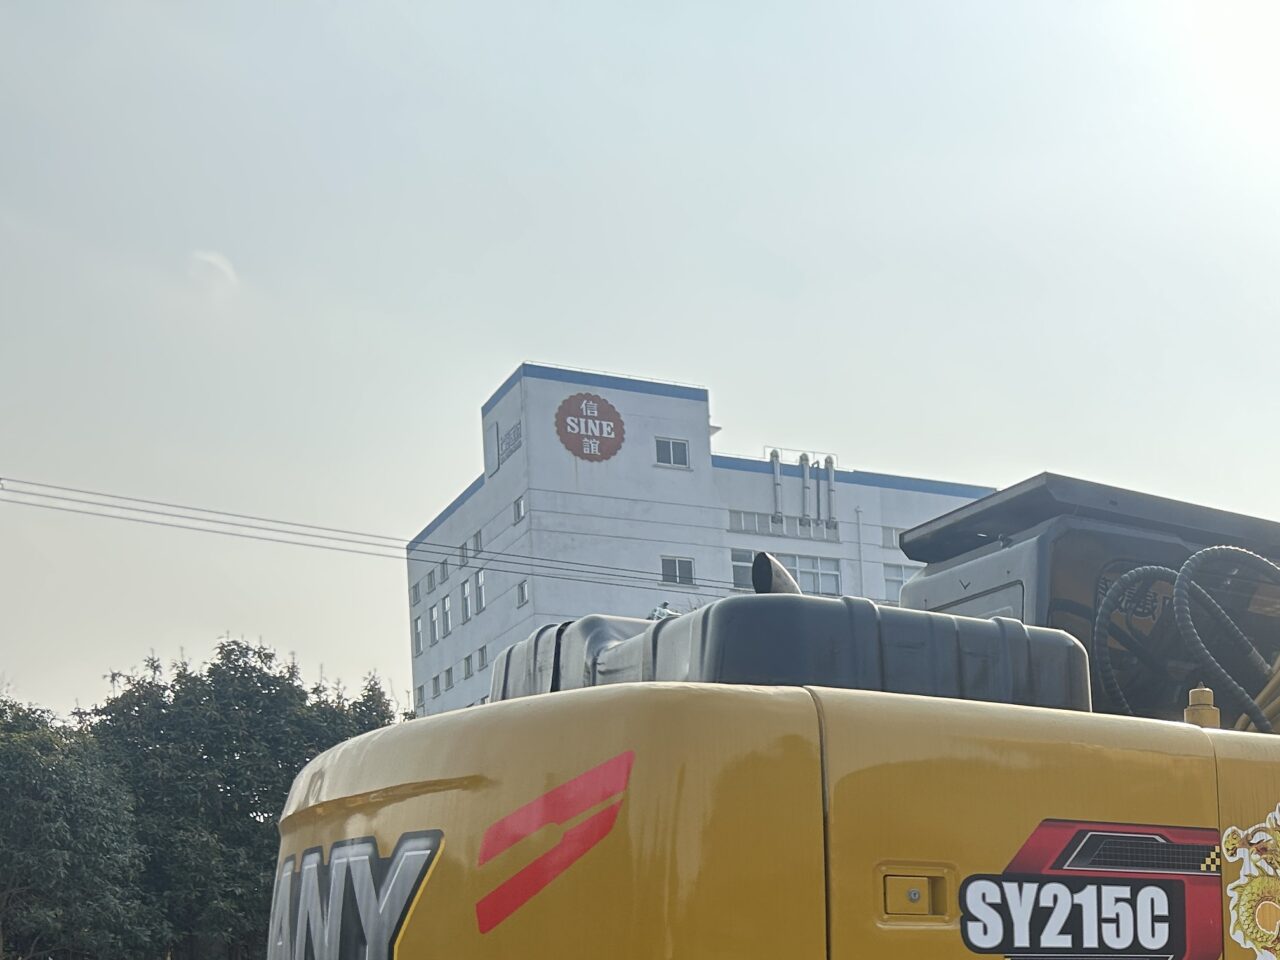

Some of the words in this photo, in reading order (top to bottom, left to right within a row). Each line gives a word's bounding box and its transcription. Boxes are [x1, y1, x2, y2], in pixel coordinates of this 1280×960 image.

[580, 400, 598, 417] 信
[566, 416, 615, 438] SINE
[965, 879, 1170, 950] SY215C
